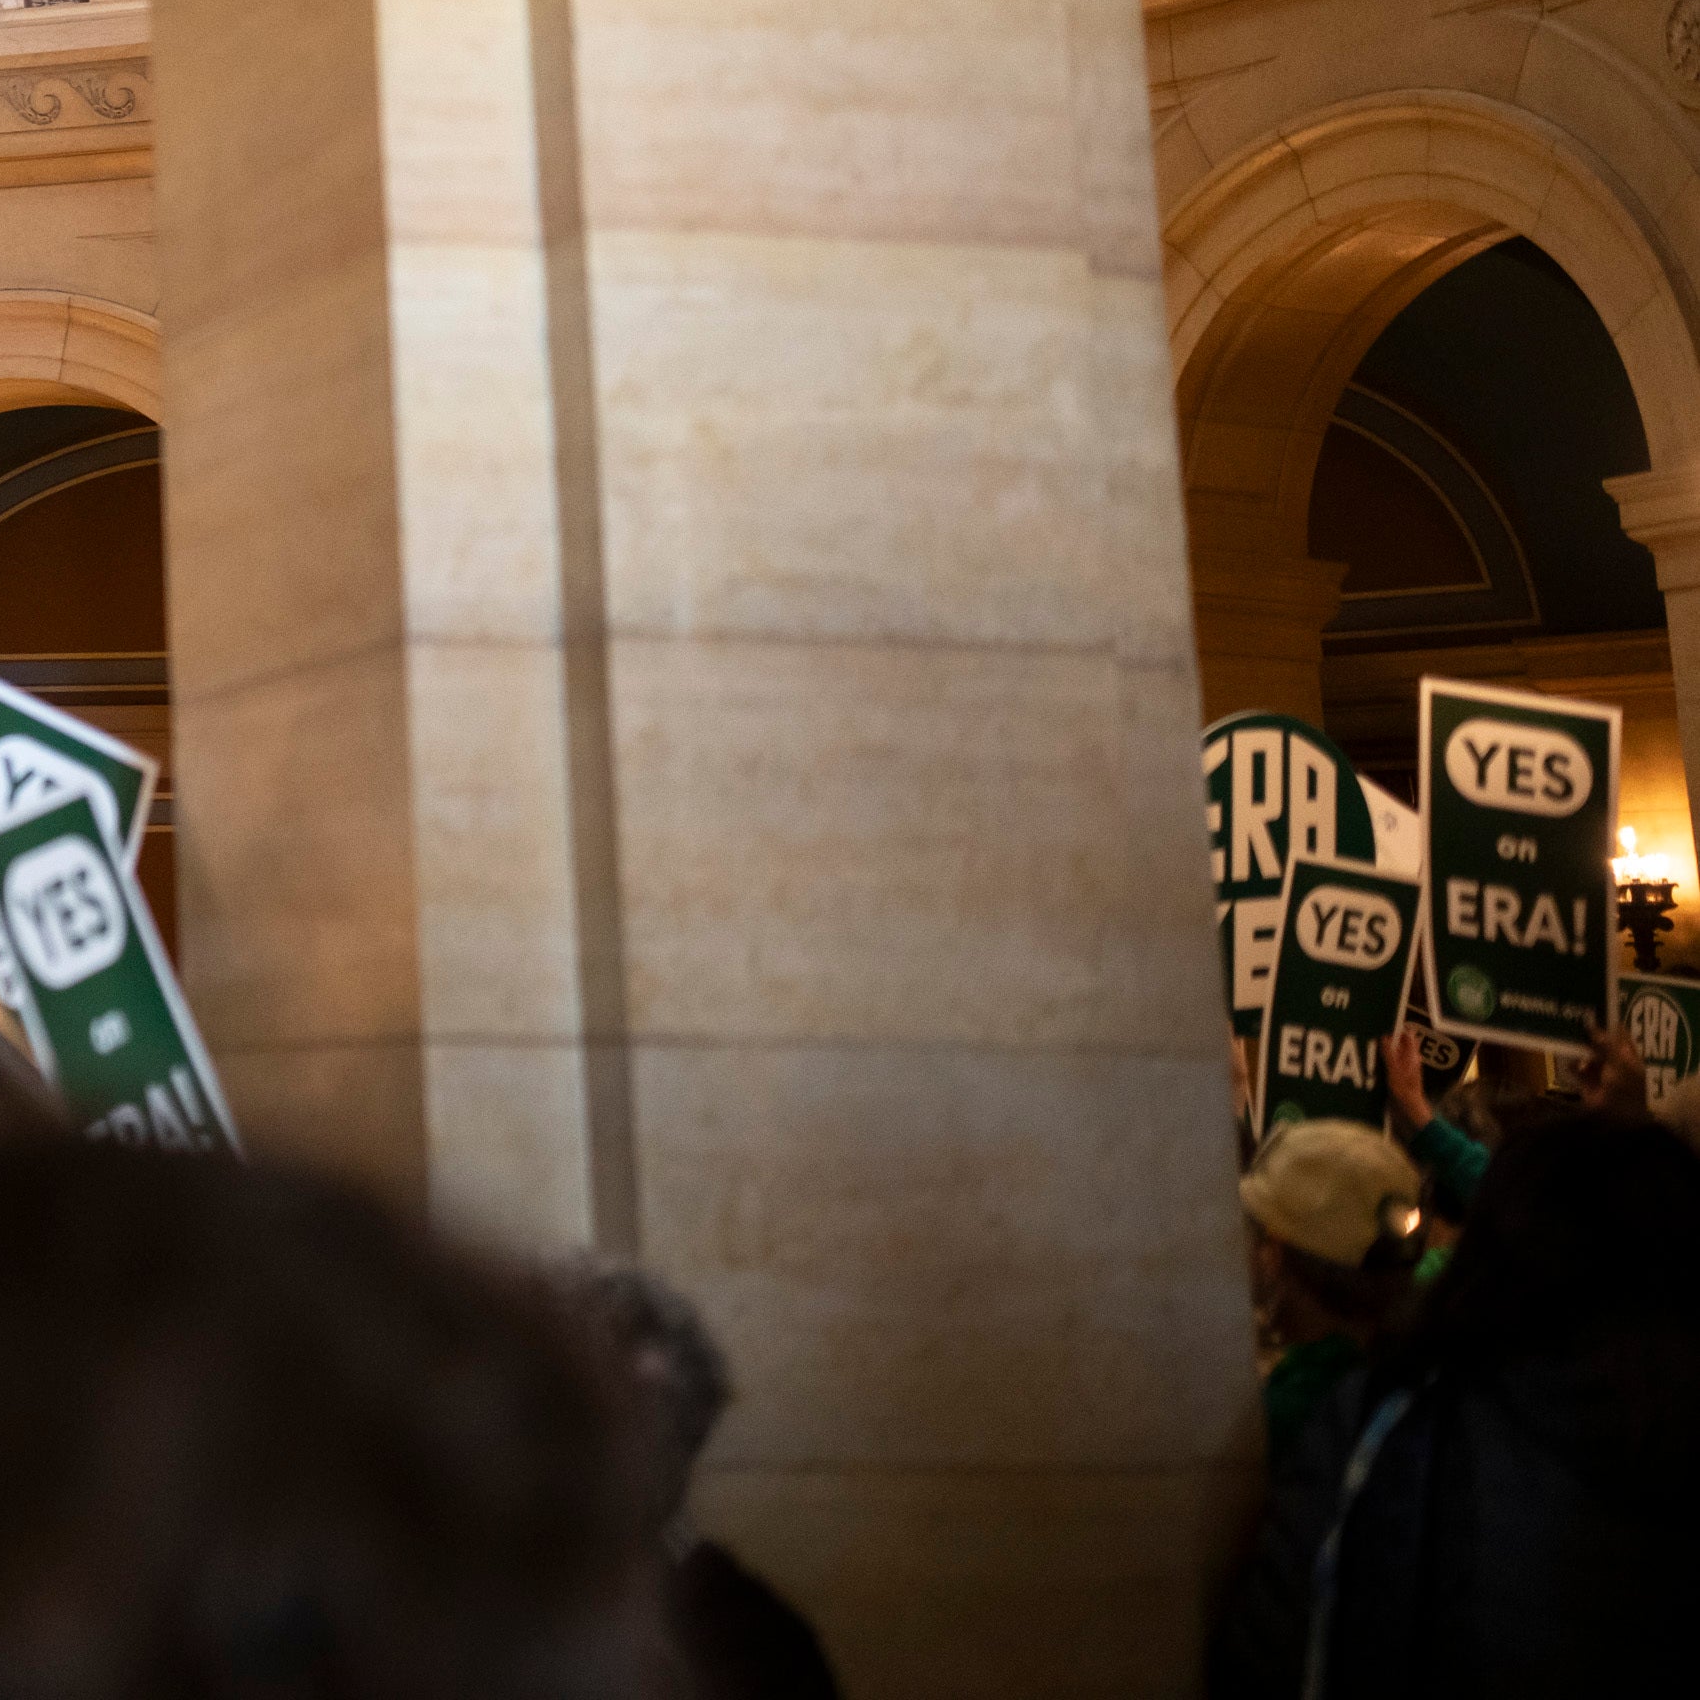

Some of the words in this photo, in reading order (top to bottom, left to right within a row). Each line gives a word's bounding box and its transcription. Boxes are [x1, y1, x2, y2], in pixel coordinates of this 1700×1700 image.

[1461, 736, 1575, 801] YES
[1496, 833, 1539, 865] on
[1312, 901, 1388, 959] YES
[1446, 875, 1588, 958] ERA!
[1320, 985, 1351, 1011] on
[1630, 994, 1679, 1061] ERA
[1277, 1023, 1378, 1092] ERA!
[1415, 1029, 1452, 1067] ES
